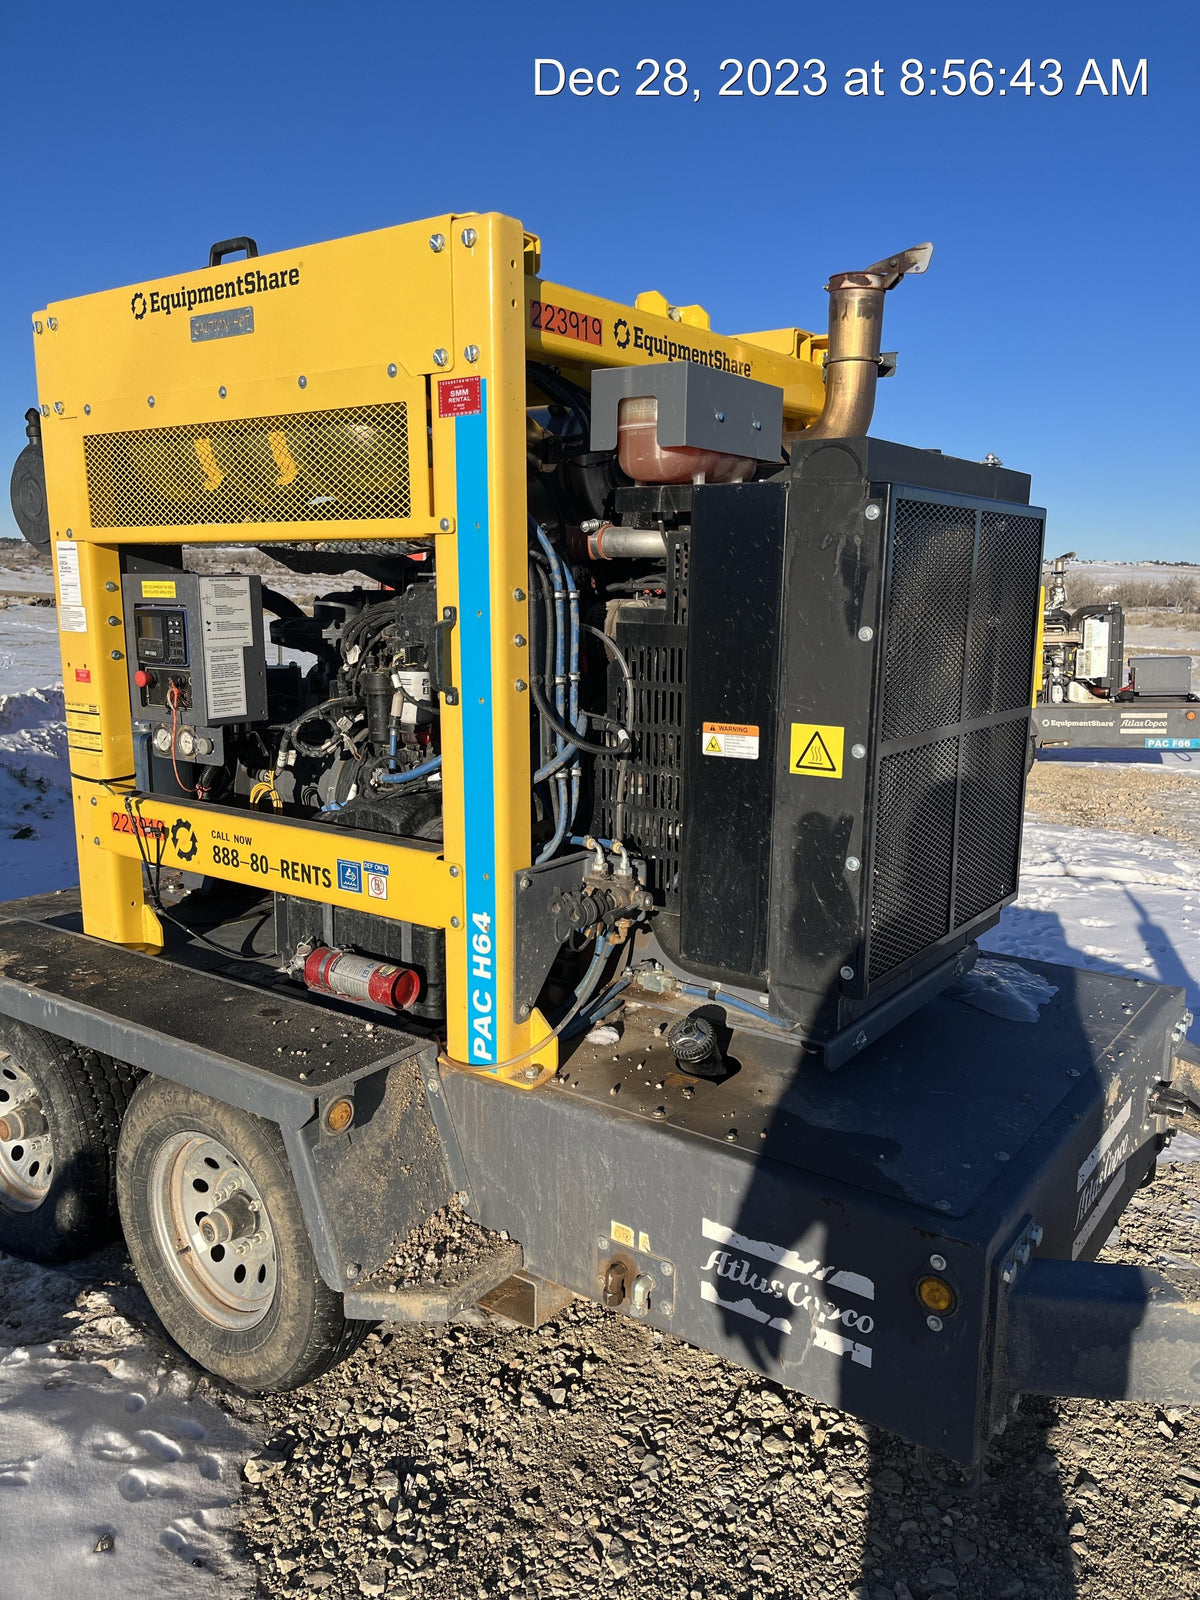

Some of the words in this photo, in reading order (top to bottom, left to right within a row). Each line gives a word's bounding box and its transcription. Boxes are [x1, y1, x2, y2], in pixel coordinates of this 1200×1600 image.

[150, 267, 300, 315] EquipmentShare
[531, 301, 602, 345] 223919
[450, 389, 468, 397] SMM
[1120, 719, 1145, 728] Atlas
[1144, 719, 1168, 729] Copco
[1148, 739, 1170, 747] PAC
[1172, 739, 1191, 747] F66
[211, 830, 230, 842] CALL
[233, 834, 252, 846] NOW
[374, 864, 389, 872] ONLY
[472, 911, 492, 980] H64
[472, 989, 493, 1061] PAC
